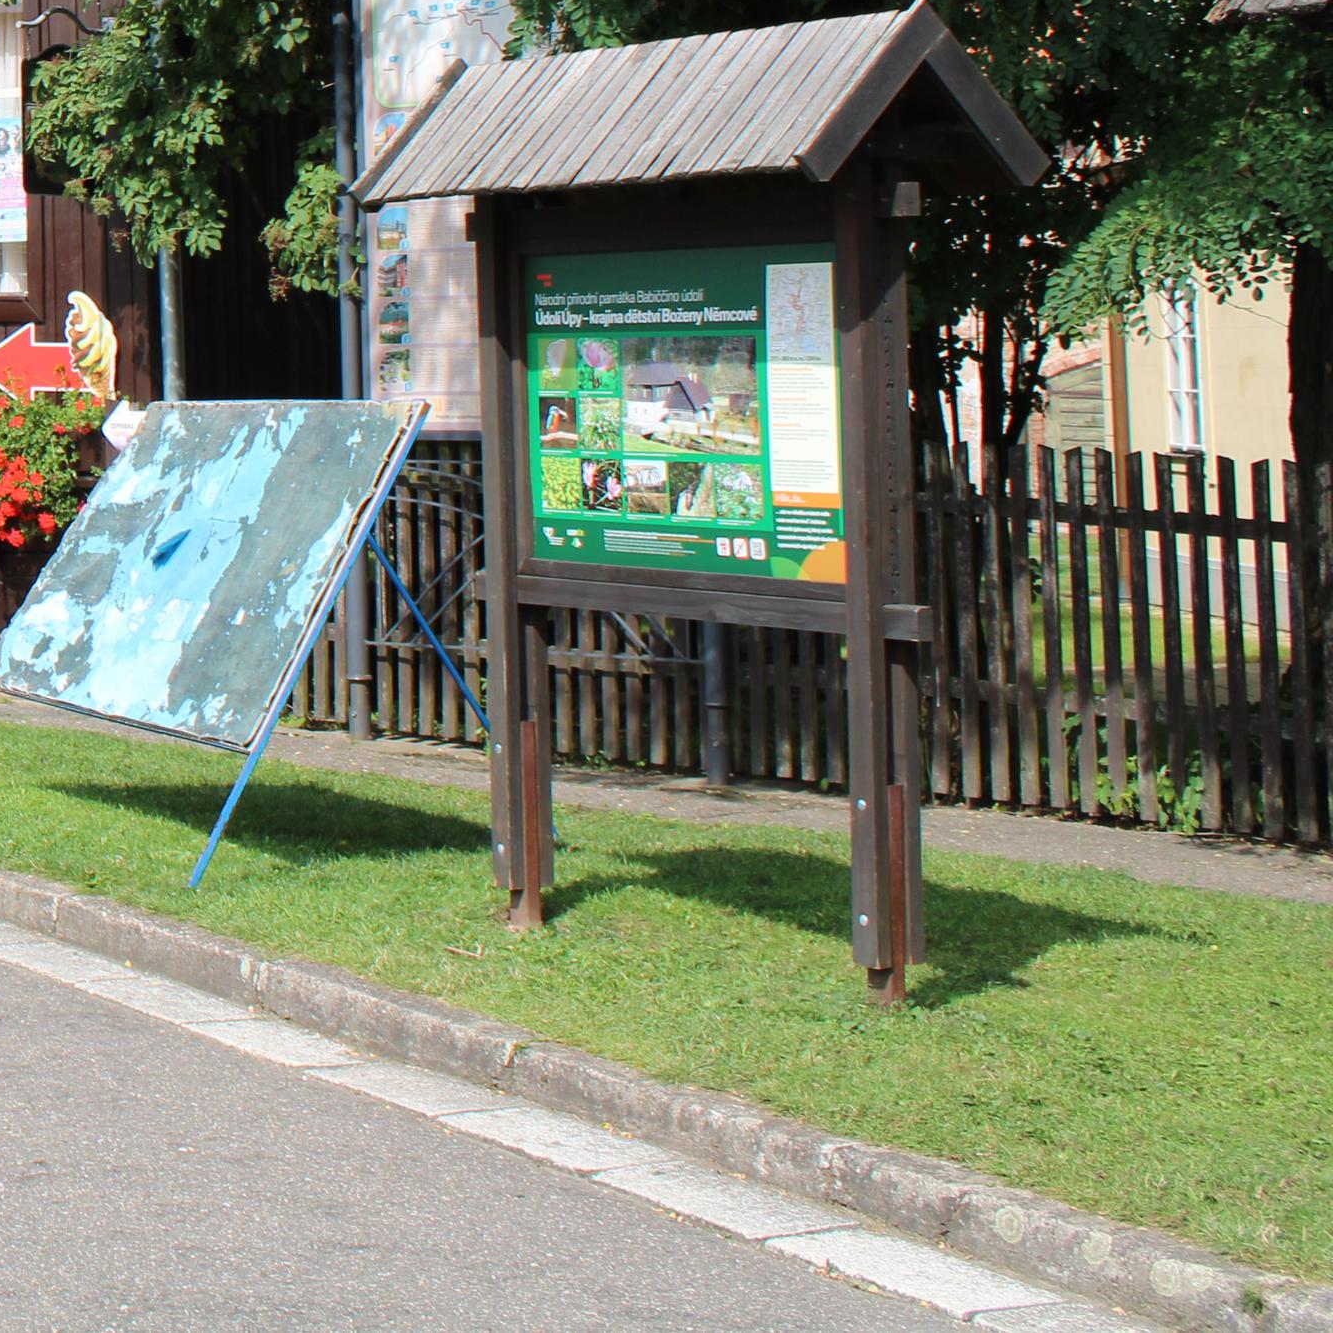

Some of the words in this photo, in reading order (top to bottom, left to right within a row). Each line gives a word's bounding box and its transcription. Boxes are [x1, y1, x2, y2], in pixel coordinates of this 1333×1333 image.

[535, 293, 566, 306] Národní
[599, 292, 635, 306] památka
[636, 289, 680, 304] Babiččino
[681, 288, 704, 302] údolí
[535, 309, 562, 326] Údolí
[562, 308, 582, 328] Úpy
[589, 309, 624, 328] krajina
[625, 308, 661, 324] dětství
[661, 306, 703, 327] Boženy
[703, 305, 758, 323] Němcové
